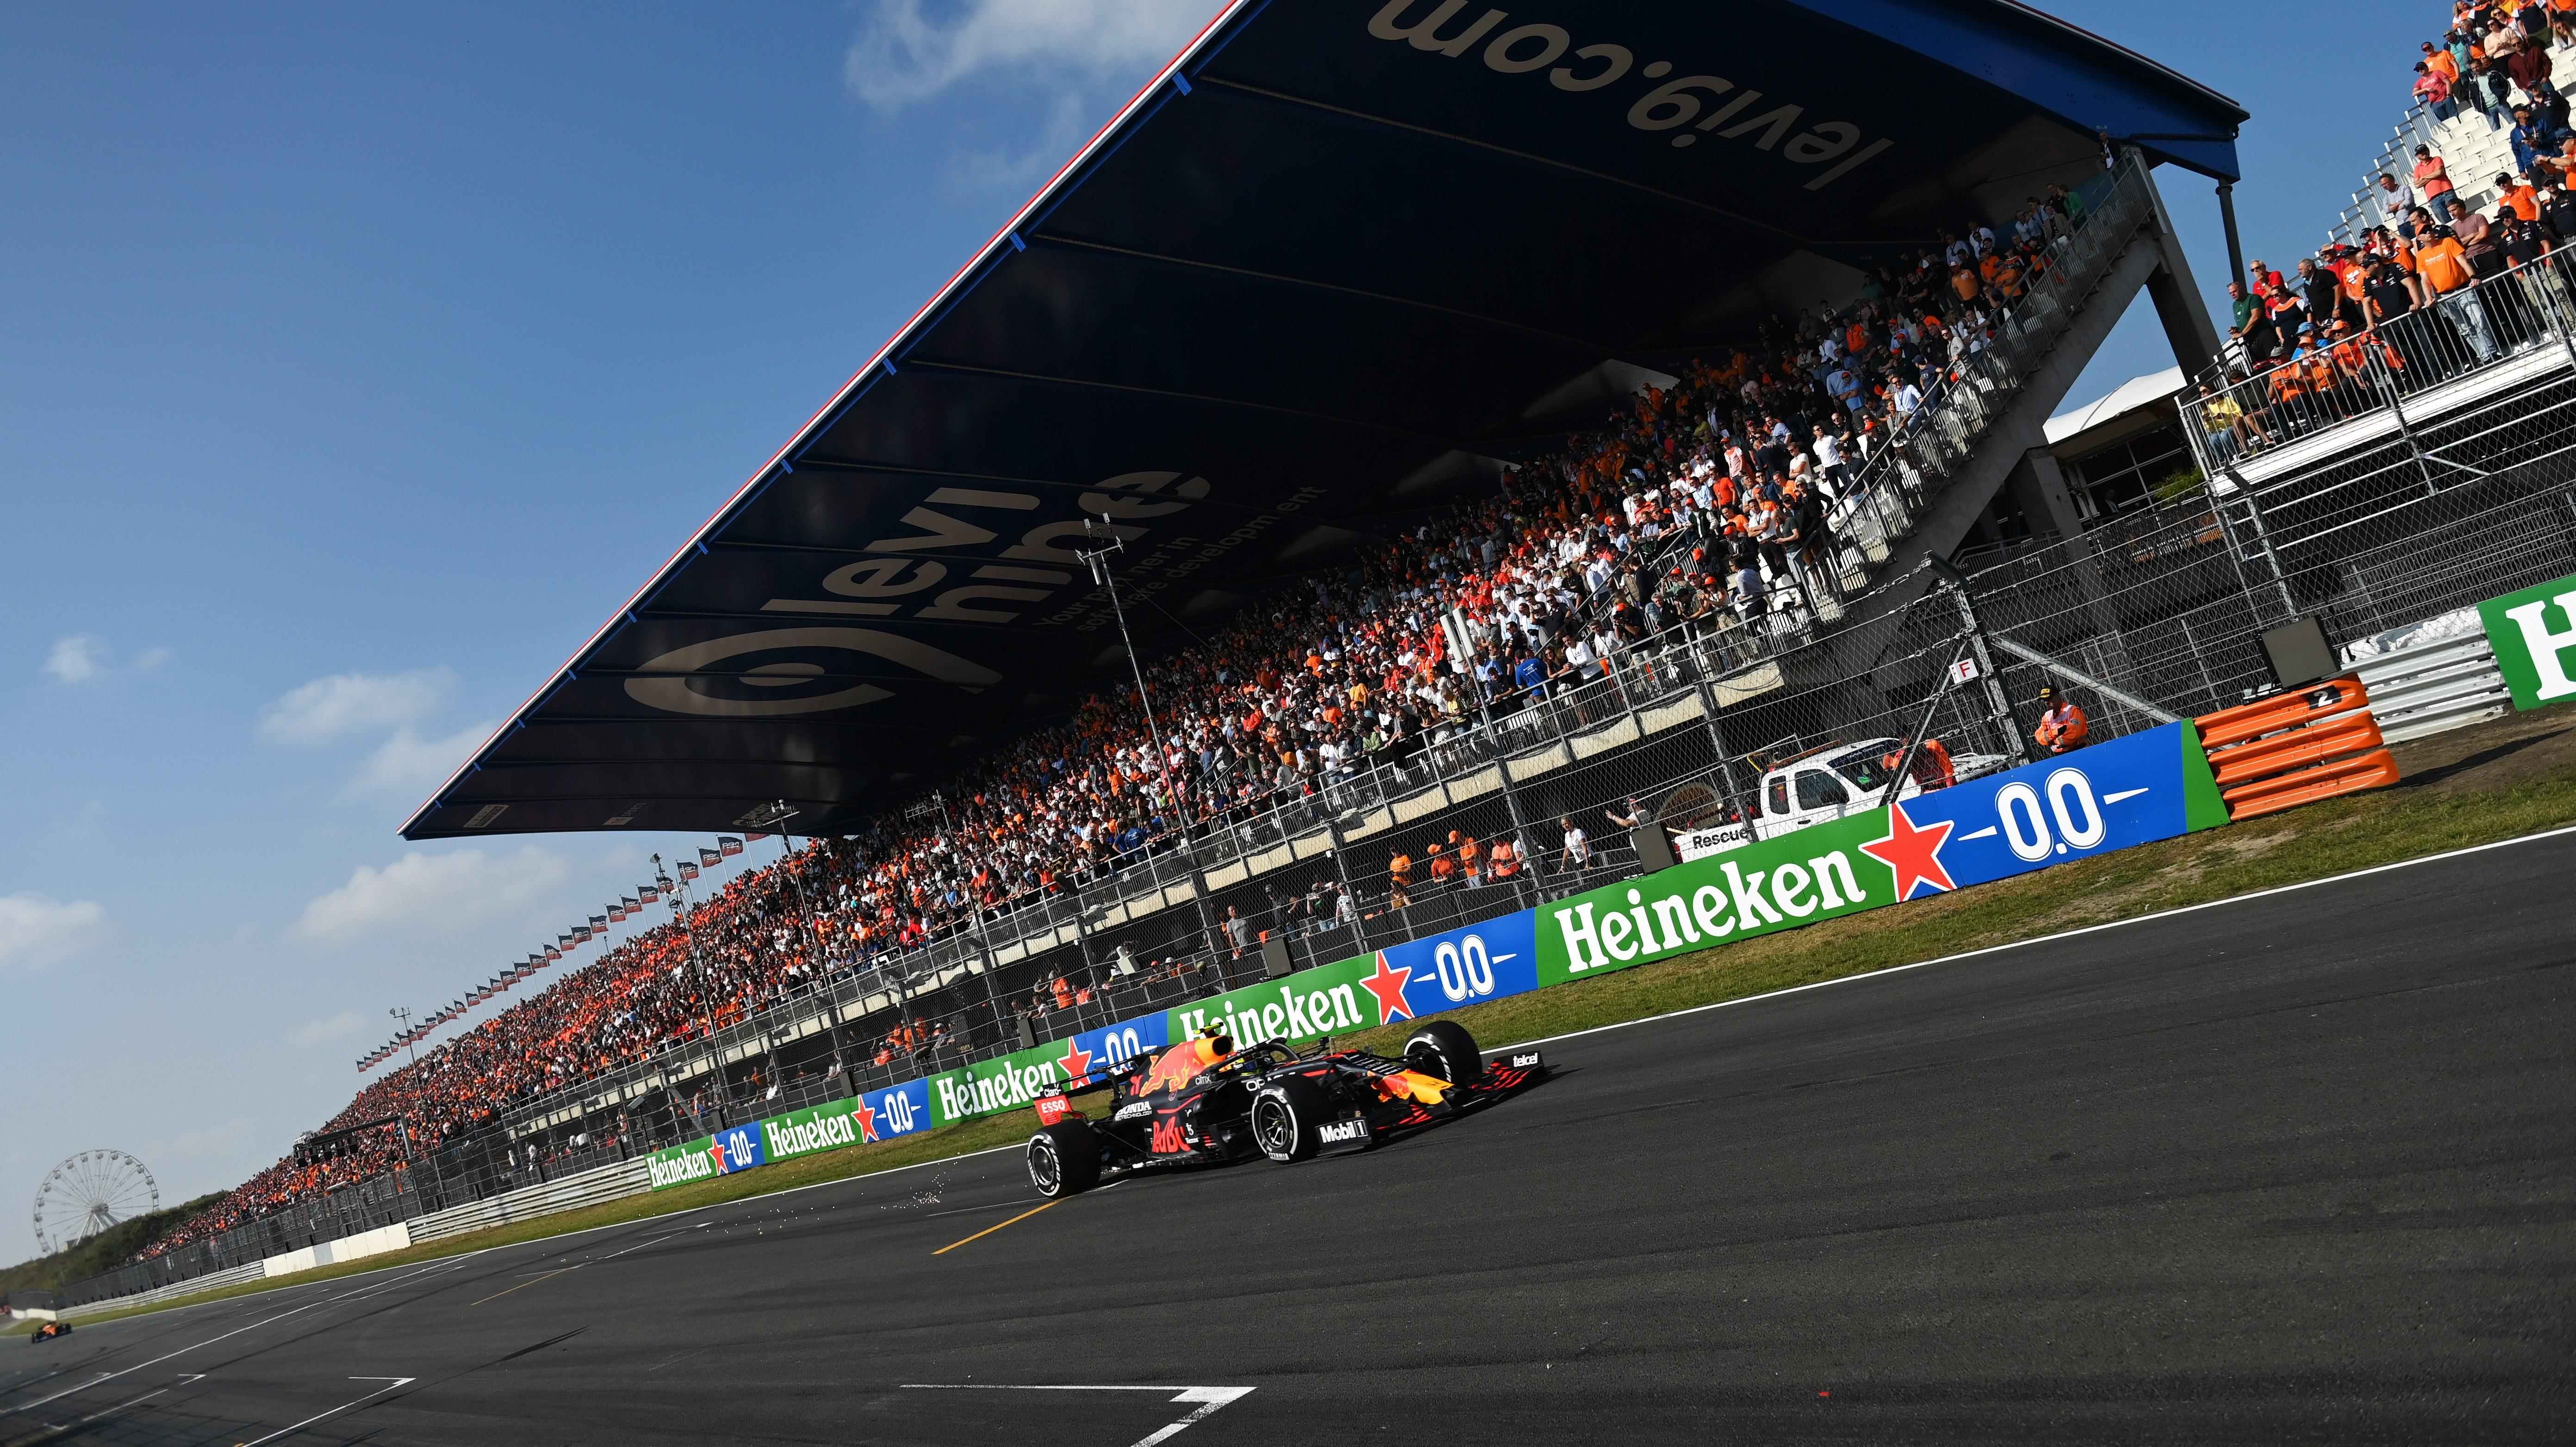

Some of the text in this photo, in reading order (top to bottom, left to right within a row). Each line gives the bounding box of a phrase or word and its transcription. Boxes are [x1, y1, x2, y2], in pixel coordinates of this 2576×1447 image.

[914, 471, 1210, 623] nine
[1033, 597, 1091, 626] Your
[1959, 662, 1970, 677] F
[2314, 690, 2333, 707] 2
[1692, 828, 1748, 849] Rescue
[1555, 850, 1867, 974] Heineken
[1513, 1052, 1538, 1068] telcel
[936, 1059, 1057, 1121] Heineken
[1044, 1086, 1061, 1098] Claro
[1115, 1101, 1152, 1116] HONDA
[765, 1112, 855, 1157] Heineken
[1319, 1120, 1356, 1143] Mobil
[647, 1148, 712, 1187] Heineken
